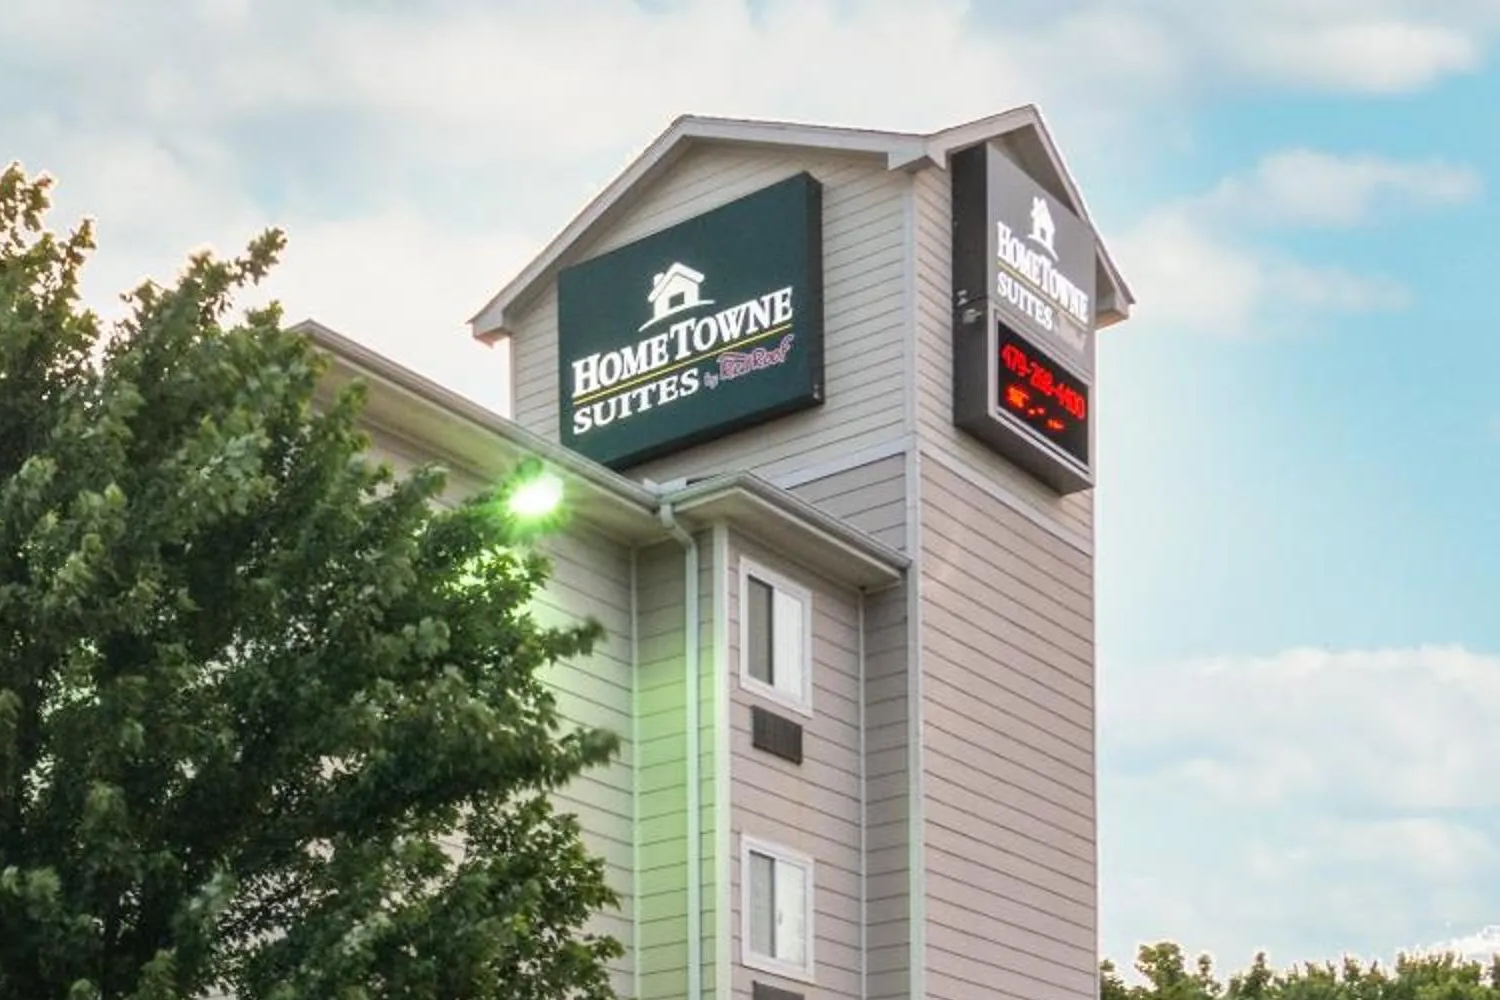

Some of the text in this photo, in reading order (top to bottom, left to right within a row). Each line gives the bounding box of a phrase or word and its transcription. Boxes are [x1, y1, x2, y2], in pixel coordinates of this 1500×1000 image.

[997, 221, 1088, 324] HOMETOWNE
[997, 271, 1052, 331] SUITES
[571, 287, 793, 398] HOMETOWNE
[573, 367, 699, 435] SUITES
